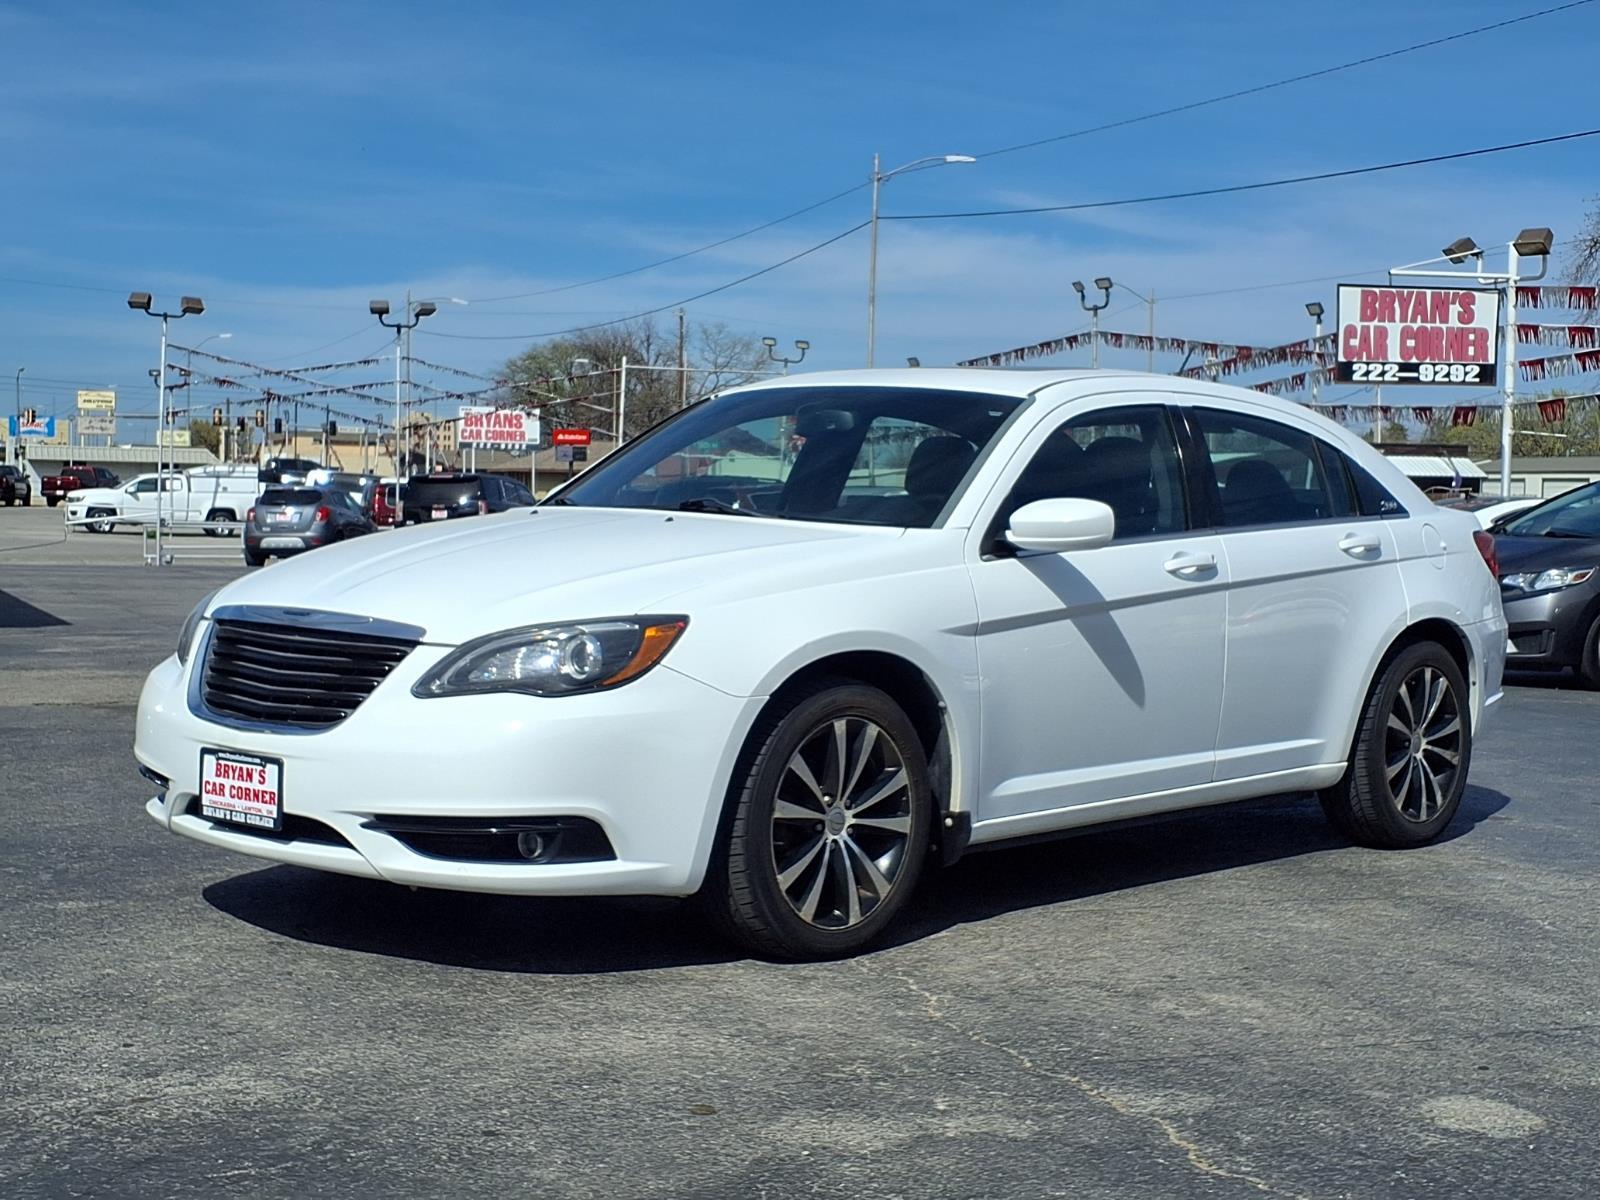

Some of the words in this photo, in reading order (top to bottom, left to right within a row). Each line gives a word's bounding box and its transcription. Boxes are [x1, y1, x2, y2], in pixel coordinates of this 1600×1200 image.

[1359, 289, 1476, 325] BRYAN'S
[1342, 323, 1389, 362] CAR
[1399, 325, 1489, 362] CORNER
[460, 428, 482, 441] CAR
[485, 429, 526, 442] CORNER
[215, 762, 266, 785] BRYAN'S
[204, 780, 225, 797] CAR
[229, 785, 276, 805] CORNER
